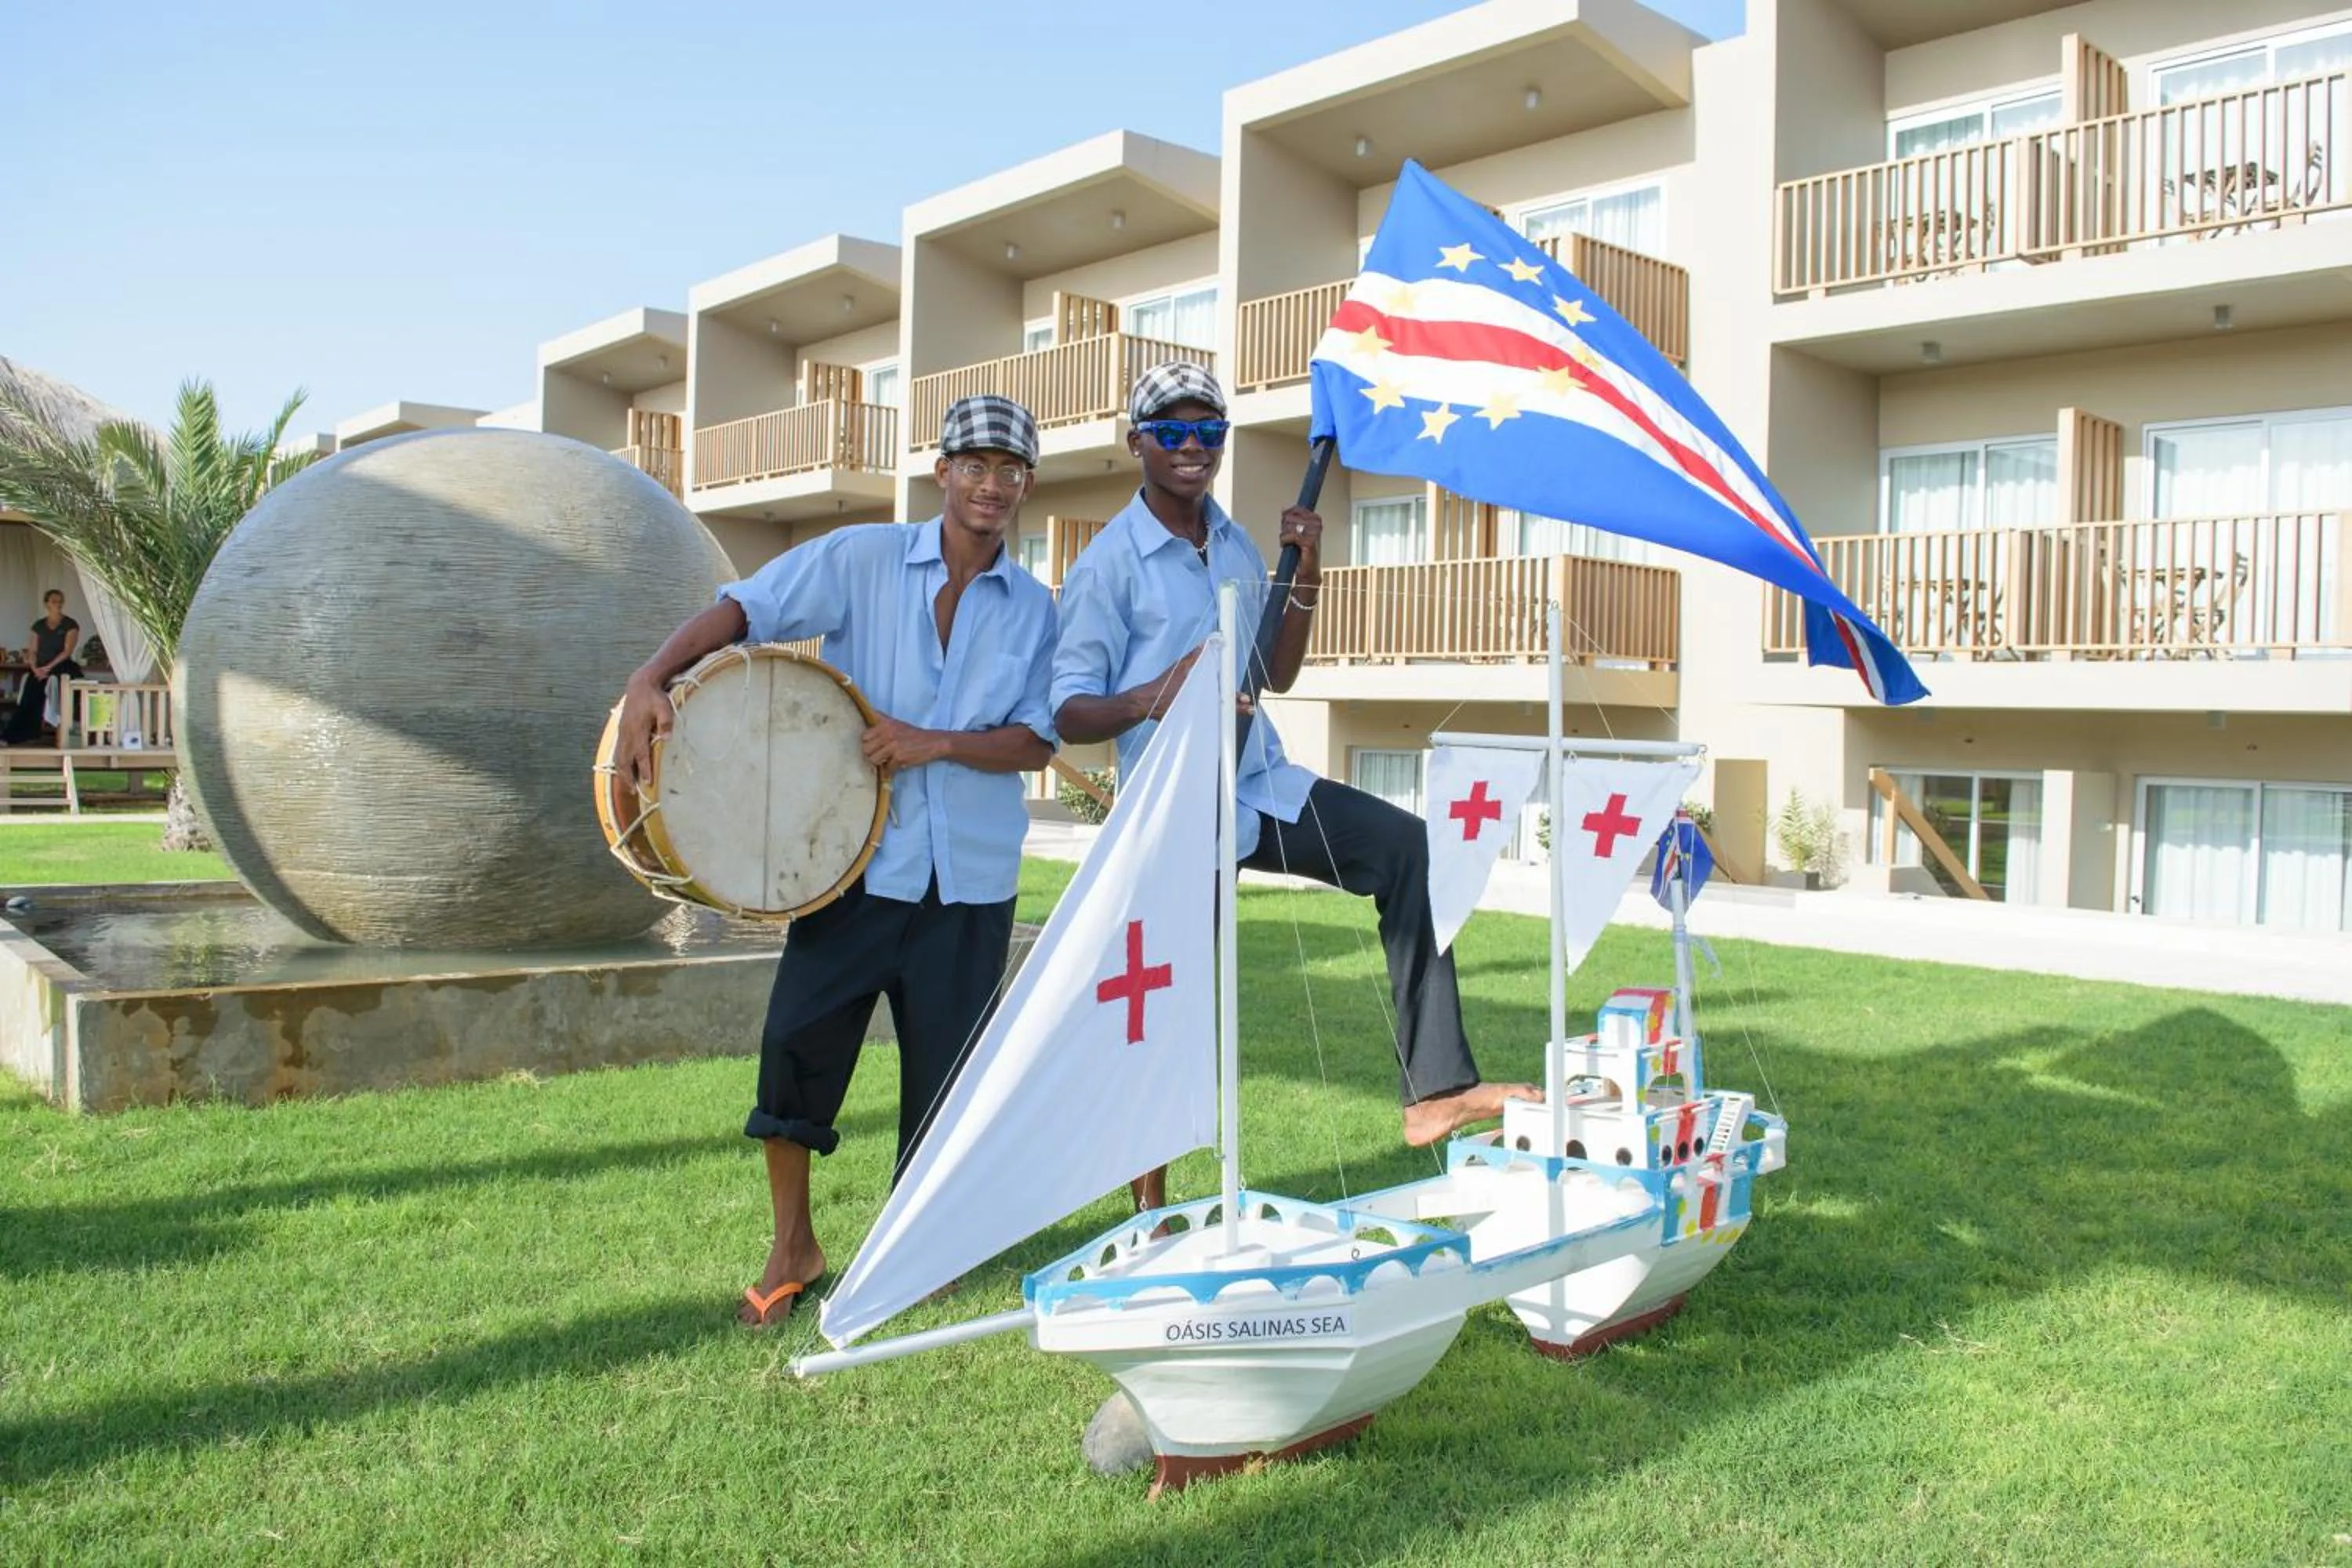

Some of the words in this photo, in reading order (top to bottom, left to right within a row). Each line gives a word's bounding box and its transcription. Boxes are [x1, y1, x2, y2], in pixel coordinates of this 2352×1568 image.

[1166, 1320, 1222, 1341] OÁSIS
[1228, 1319, 1306, 1338] SALINAS
[1310, 1316, 1345, 1334] SEA
